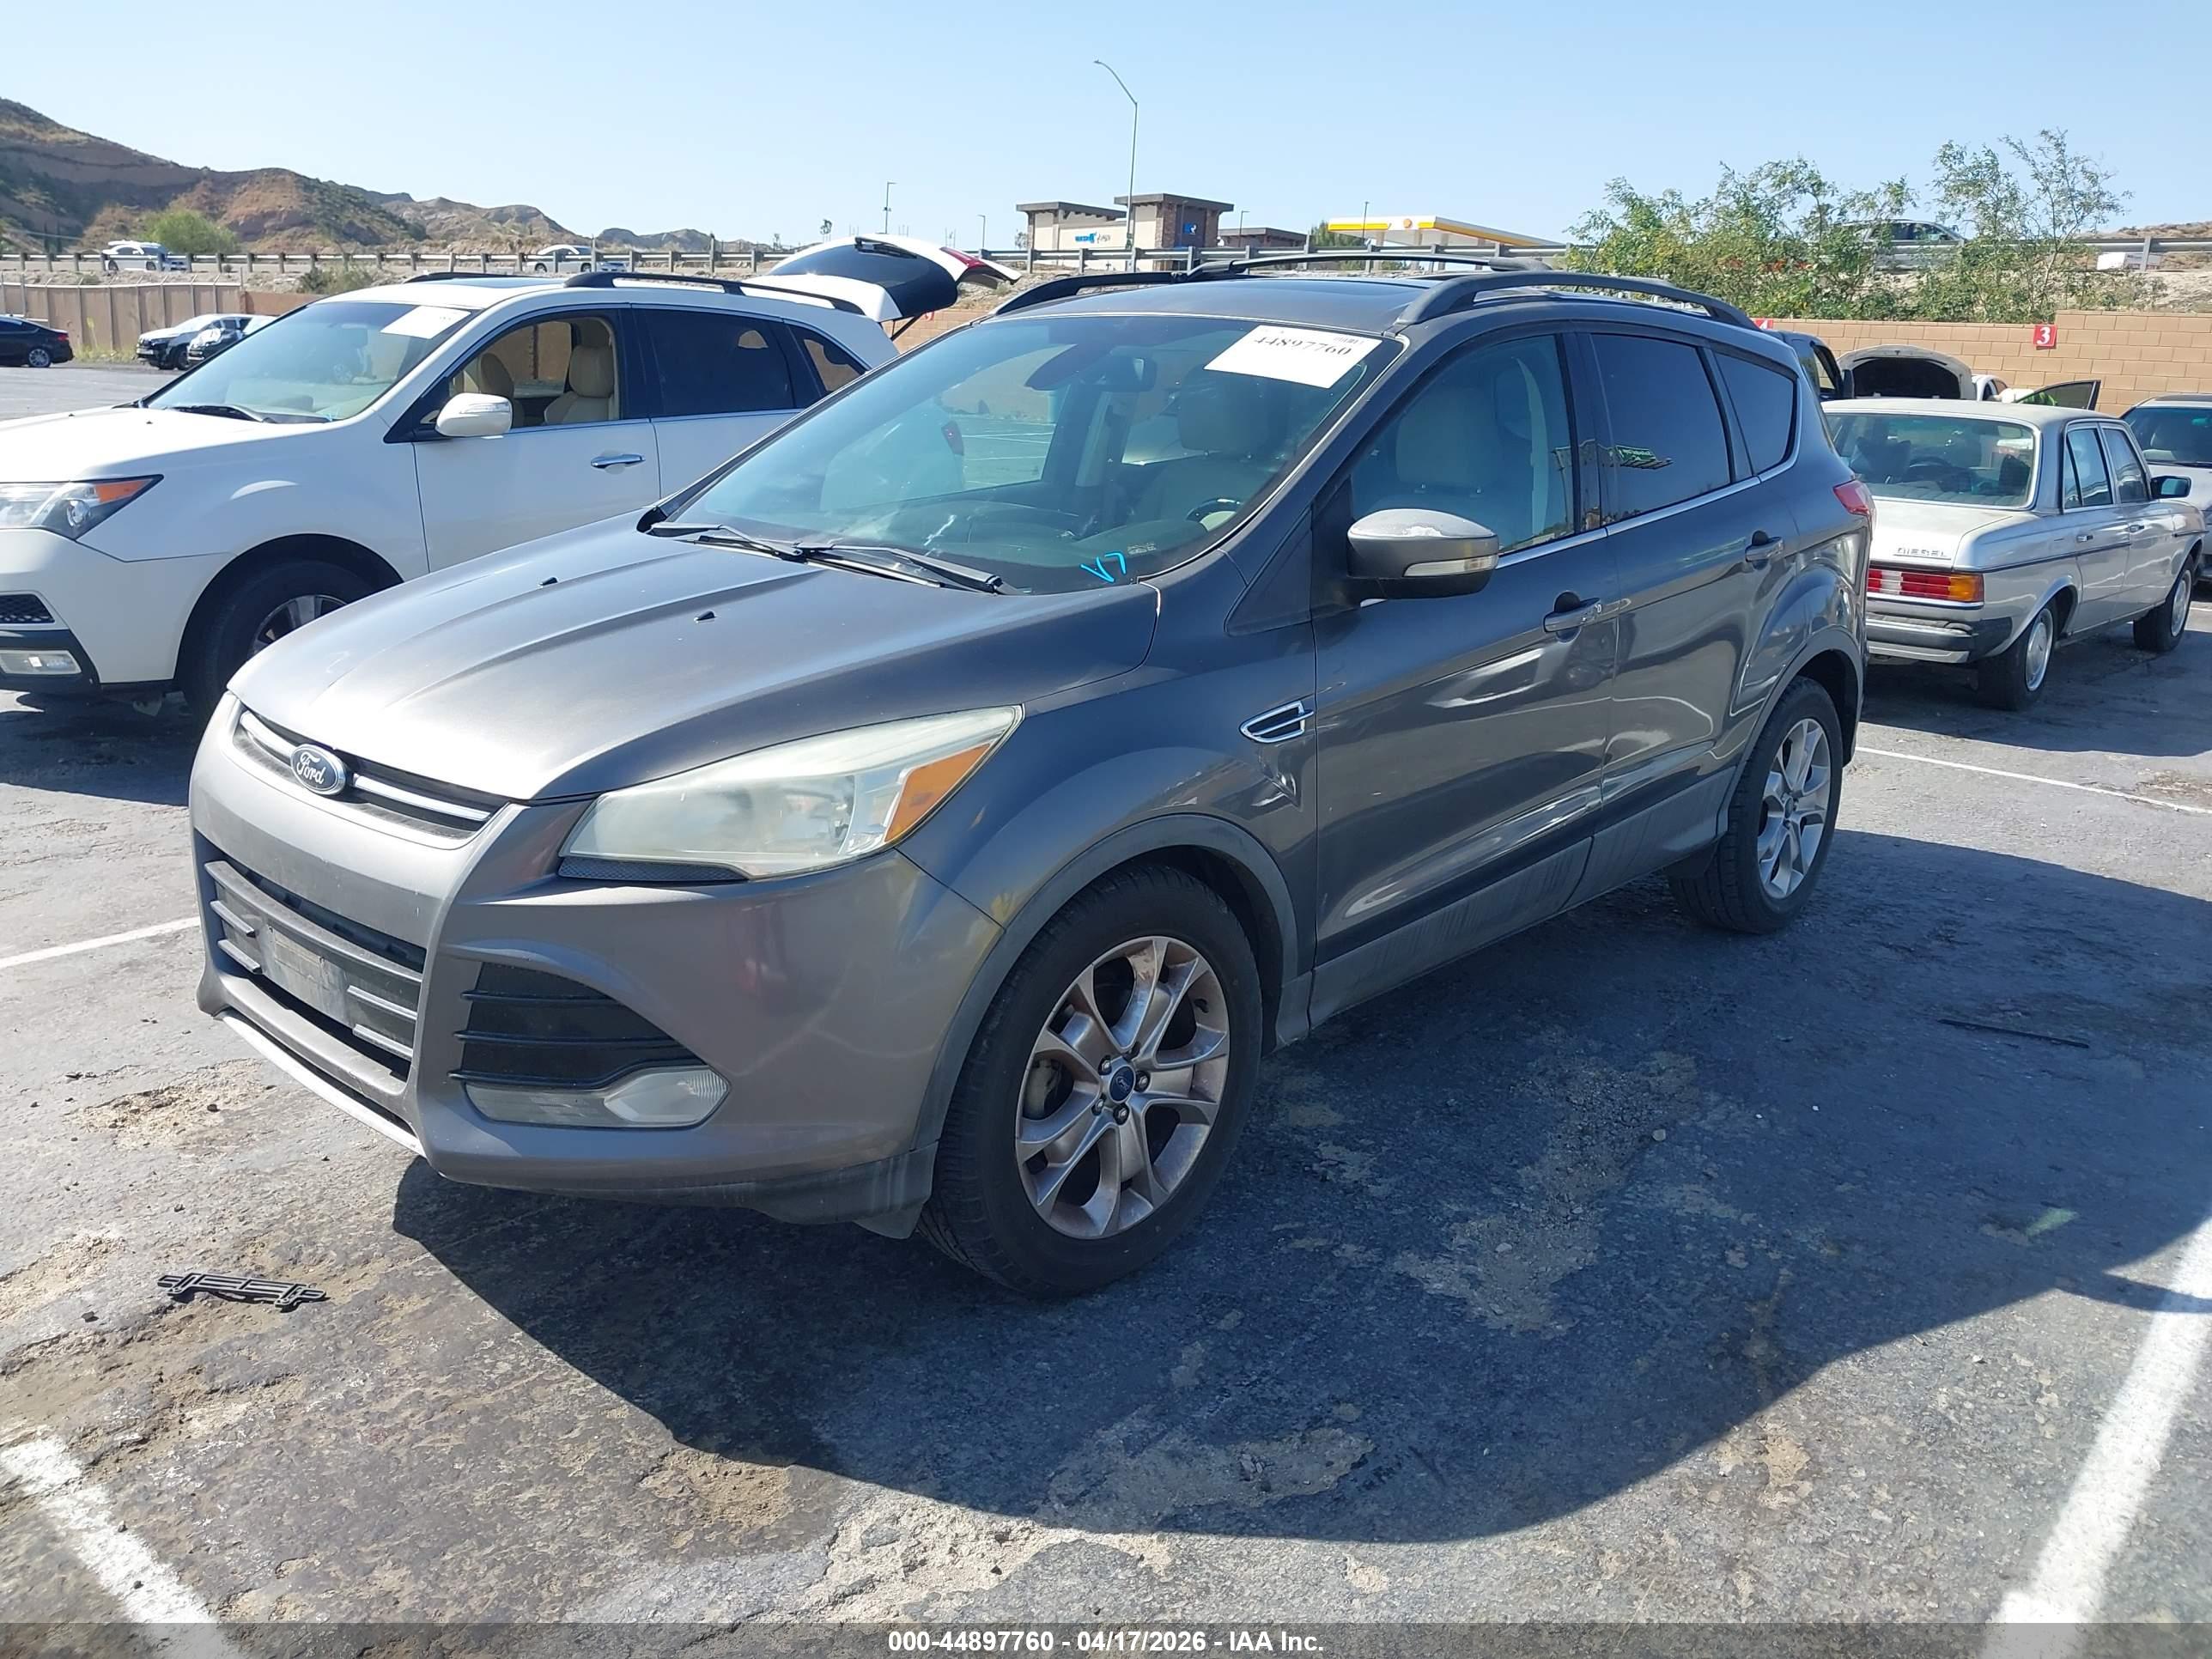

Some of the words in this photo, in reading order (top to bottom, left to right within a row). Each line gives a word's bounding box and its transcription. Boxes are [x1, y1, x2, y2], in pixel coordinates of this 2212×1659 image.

[2036, 326, 2051, 345] 3
[1253, 336, 1352, 356] 44897760
[1894, 546, 1949, 558] DIESEL
[296, 750, 326, 785] Ford
